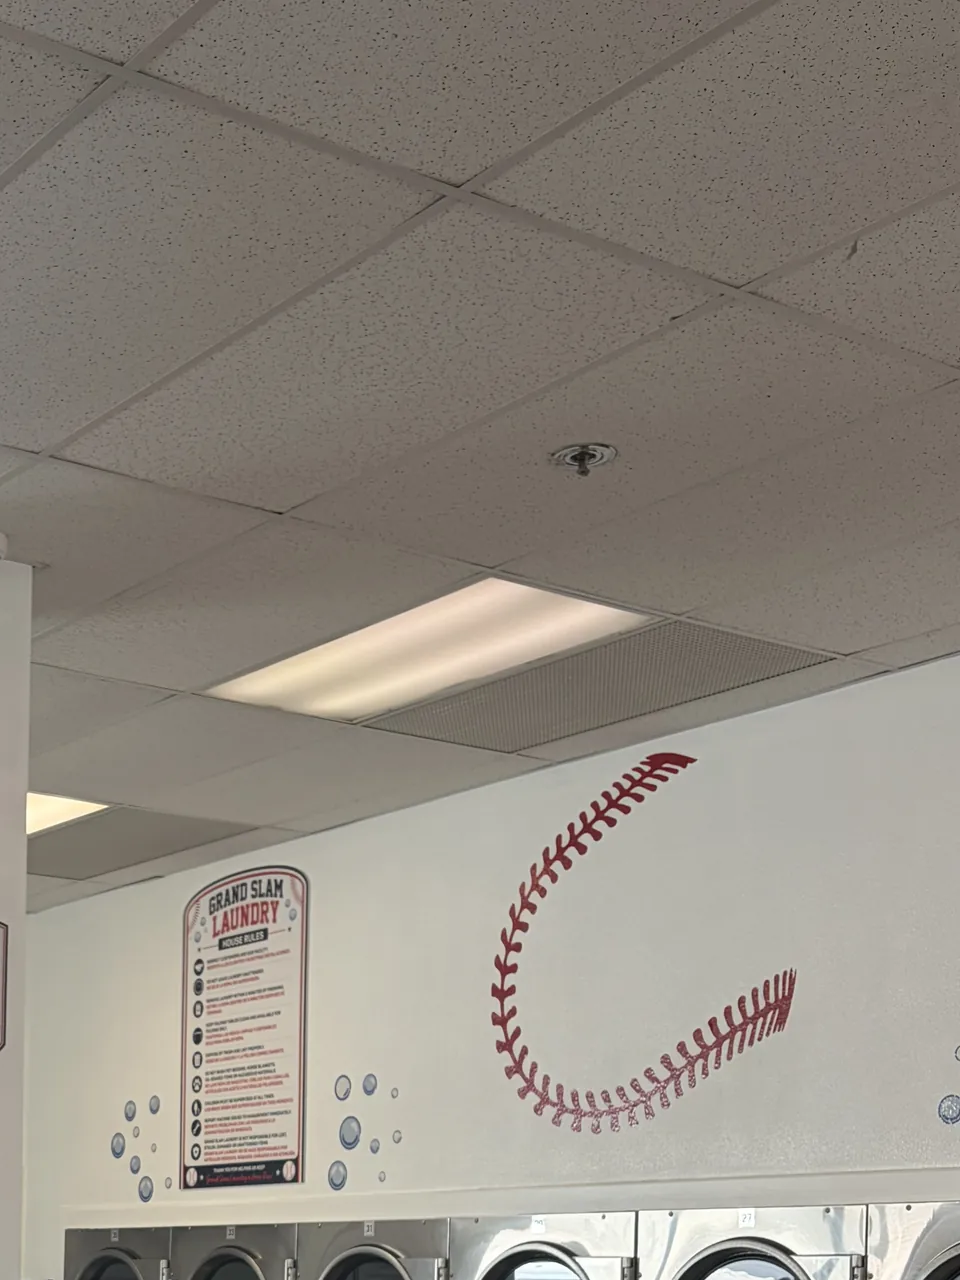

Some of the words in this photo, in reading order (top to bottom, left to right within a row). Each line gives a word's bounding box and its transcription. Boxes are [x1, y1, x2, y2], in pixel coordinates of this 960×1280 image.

[209, 882, 248, 916] GRAND
[250, 878, 284, 899] SLAM
[212, 900, 280, 938] LAUNDRY
[222, 936, 243, 948] HOUSE
[243, 931, 265, 943] RULES
